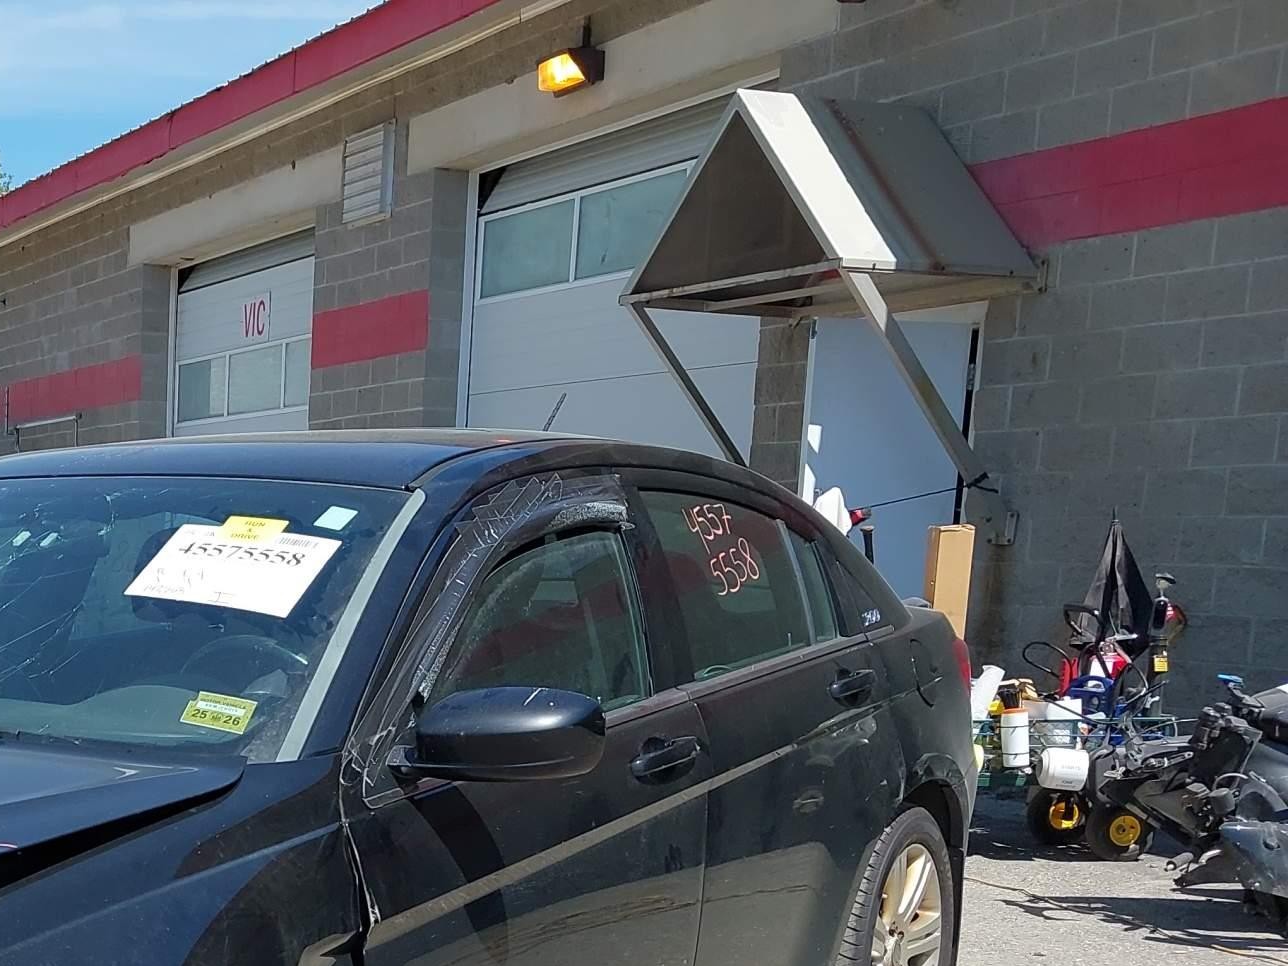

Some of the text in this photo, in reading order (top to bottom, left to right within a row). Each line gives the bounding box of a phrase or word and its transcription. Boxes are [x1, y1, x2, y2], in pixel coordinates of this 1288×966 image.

[244, 299, 266, 338] VIC
[681, 504, 732, 555] 4557
[179, 541, 306, 567] 45575558
[710, 537, 760, 596] 5558
[192, 708, 208, 719] 25
[223, 715, 242, 726] 26
